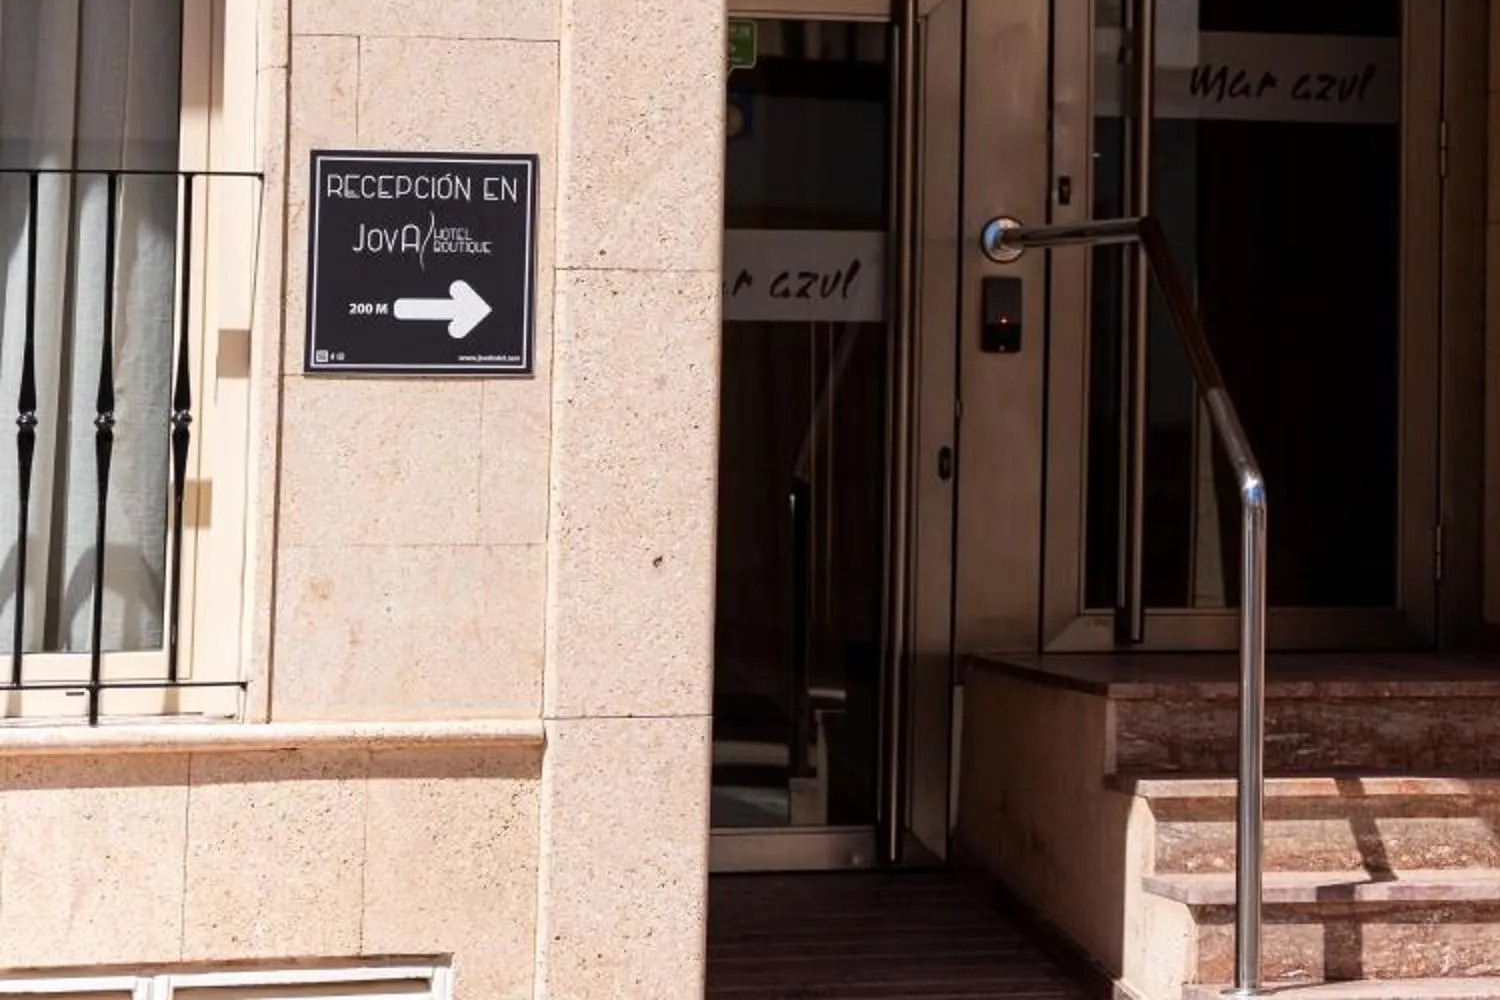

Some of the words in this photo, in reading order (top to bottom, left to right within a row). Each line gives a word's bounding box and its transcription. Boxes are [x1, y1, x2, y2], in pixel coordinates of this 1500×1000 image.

[1291, 63, 1377, 102] azul
[327, 173, 471, 202] RECEPCIÓN
[483, 176, 518, 203] EN
[433, 227, 473, 240] HOTEL
[433, 240, 492, 254] BOUTIQUE
[769, 258, 861, 300] azul
[349, 303, 373, 315] 200
[375, 303, 389, 315] M
